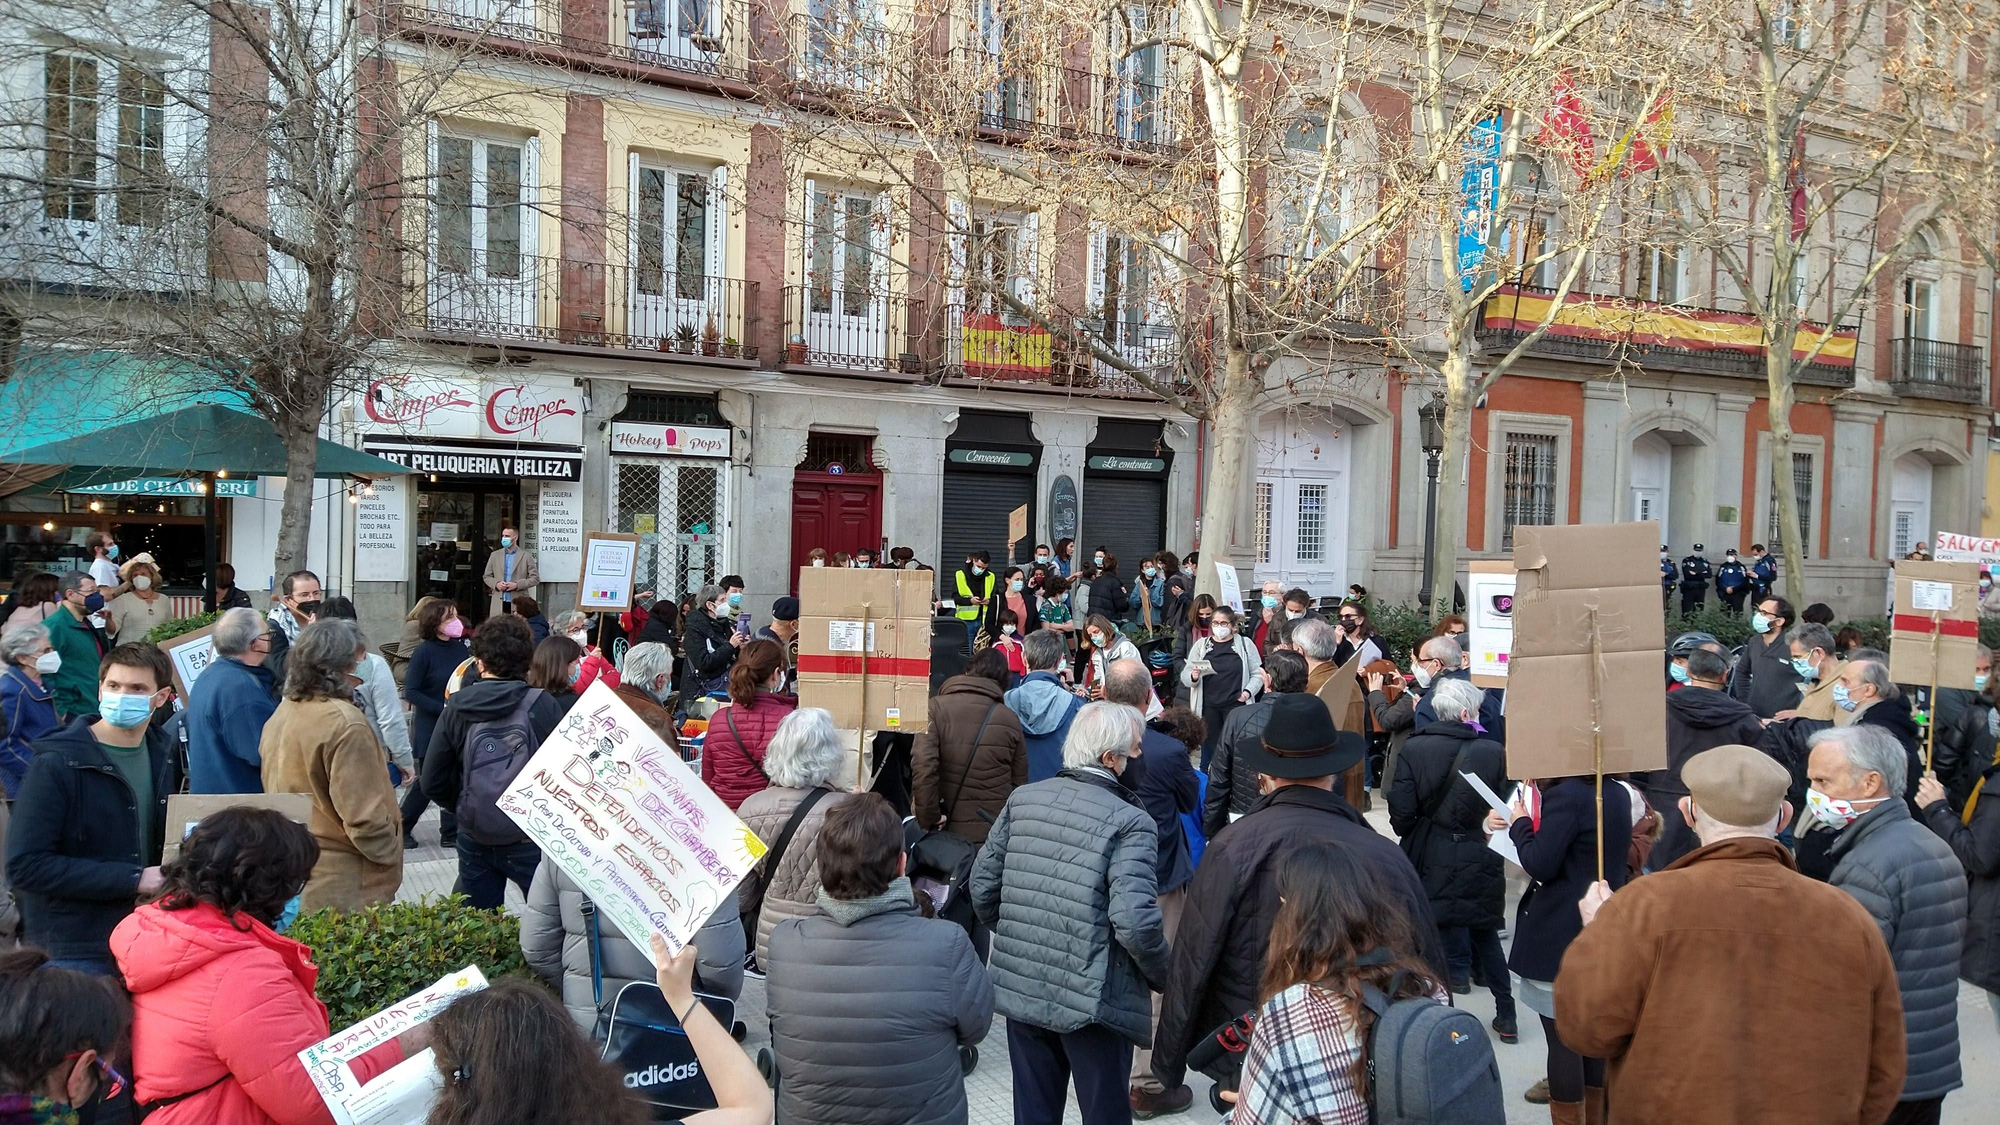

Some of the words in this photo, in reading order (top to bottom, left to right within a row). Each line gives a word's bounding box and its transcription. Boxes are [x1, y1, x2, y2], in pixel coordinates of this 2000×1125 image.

[616, 432, 663, 450] Hokey
[690, 438, 722, 452] Pops
[411, 454, 500, 474] PELUQUERIA
[501, 459, 511, 475] Y
[514, 459, 572, 477] BELLEZA
[966, 450, 1011, 464] Cervecería
[1102, 456, 1117, 469] La
[1118, 460, 1153, 470] contenta
[112, 480, 138, 492] DE
[144, 480, 250, 495] CHAMERÍ
[360, 484, 395, 492] AESORIOS
[541, 527, 578, 535] HERRAMIENTAS
[589, 704, 629, 745] LAS
[532, 768, 610, 841] NUESTROS
[563, 753, 686, 879] DEFENDEMOS
[638, 791, 673, 822] DE
[516, 784, 533, 799] LA
[532, 798, 554, 819] CASA
[592, 855, 603, 867] Y
[527, 817, 551, 840] SE
[550, 840, 588, 878] QUEDA
[617, 902, 655, 946] BARRI
[327, 993, 446, 1053] NUESTRA
[319, 1060, 345, 1093] CASA
[623, 1062, 698, 1089] adidas
